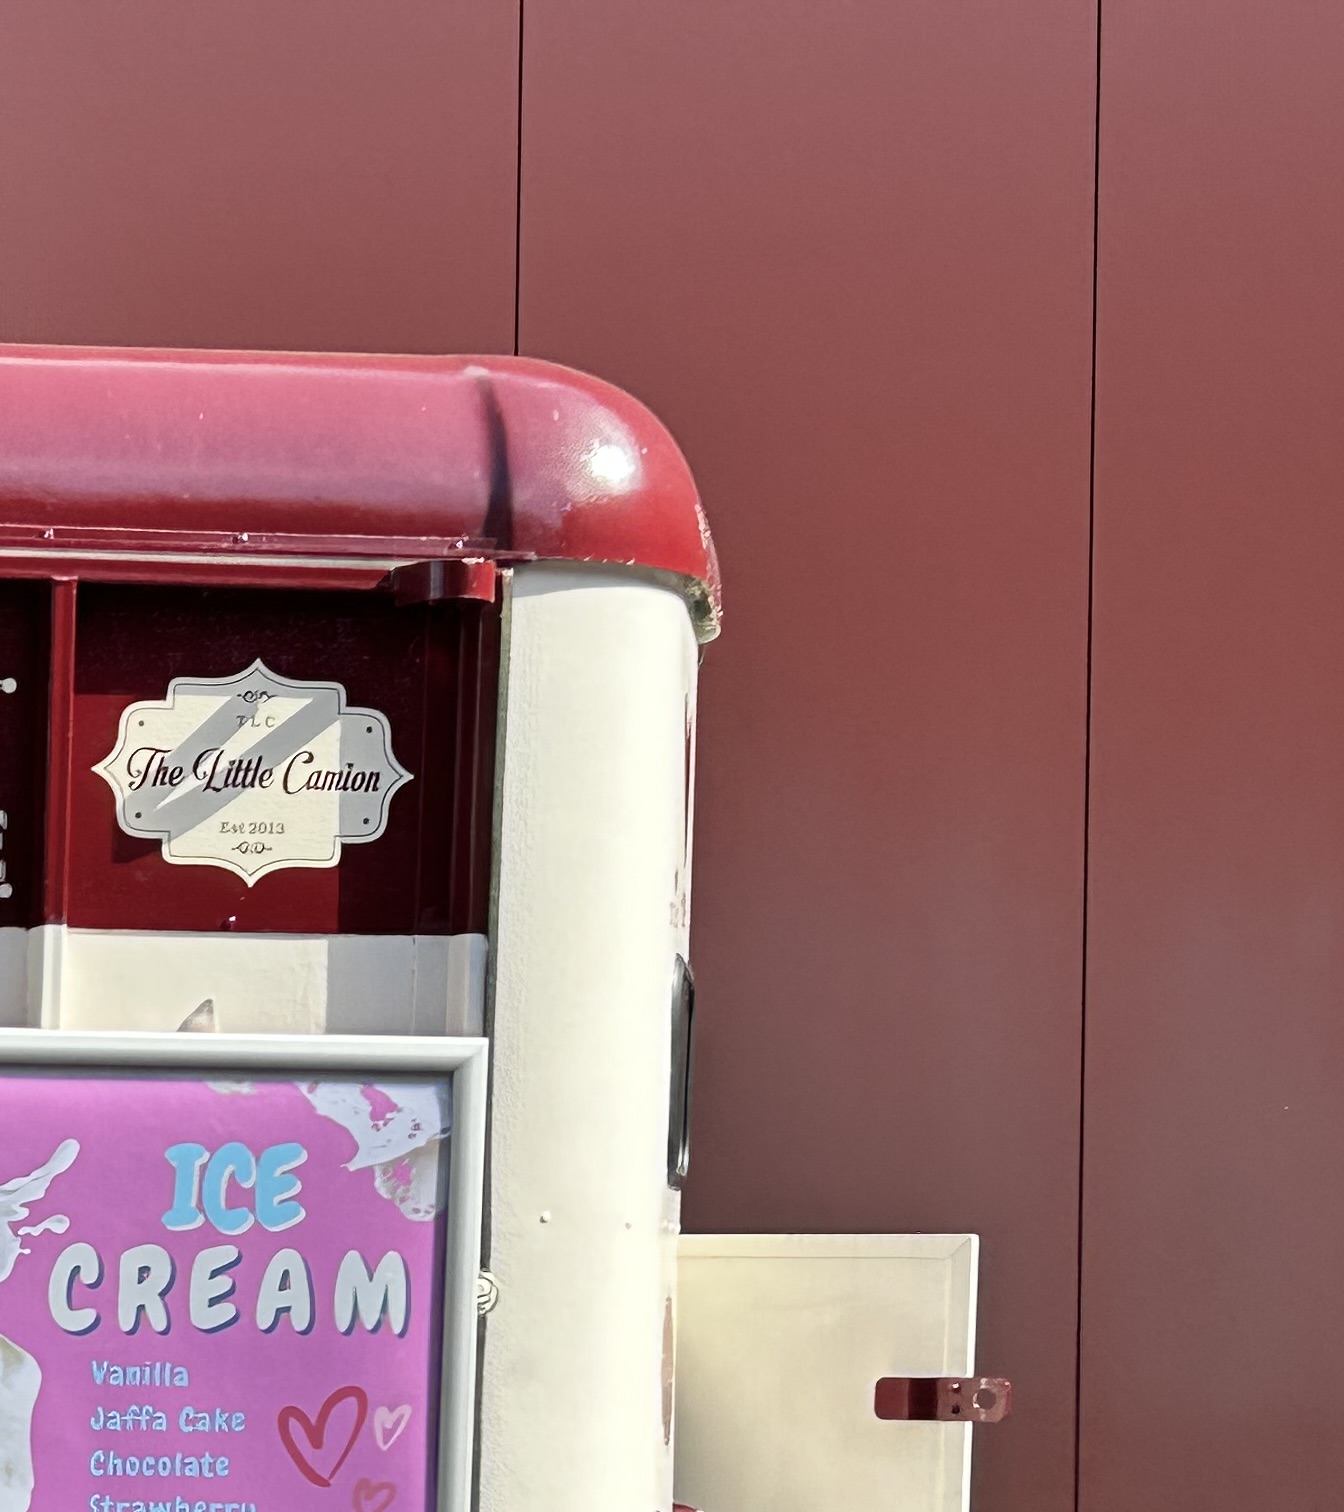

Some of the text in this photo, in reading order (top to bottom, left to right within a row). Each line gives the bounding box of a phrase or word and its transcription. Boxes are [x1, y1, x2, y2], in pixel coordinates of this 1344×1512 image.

[126, 746, 381, 796] The Little Camion
[248, 822, 286, 835] 2013
[161, 1141, 308, 1236] ICE
[48, 1242, 412, 1339] CREAM
[90, 1360, 189, 1387] Vanilla
[90, 1405, 246, 1434] Jaffa Cake
[90, 1450, 230, 1478] Chocolate
